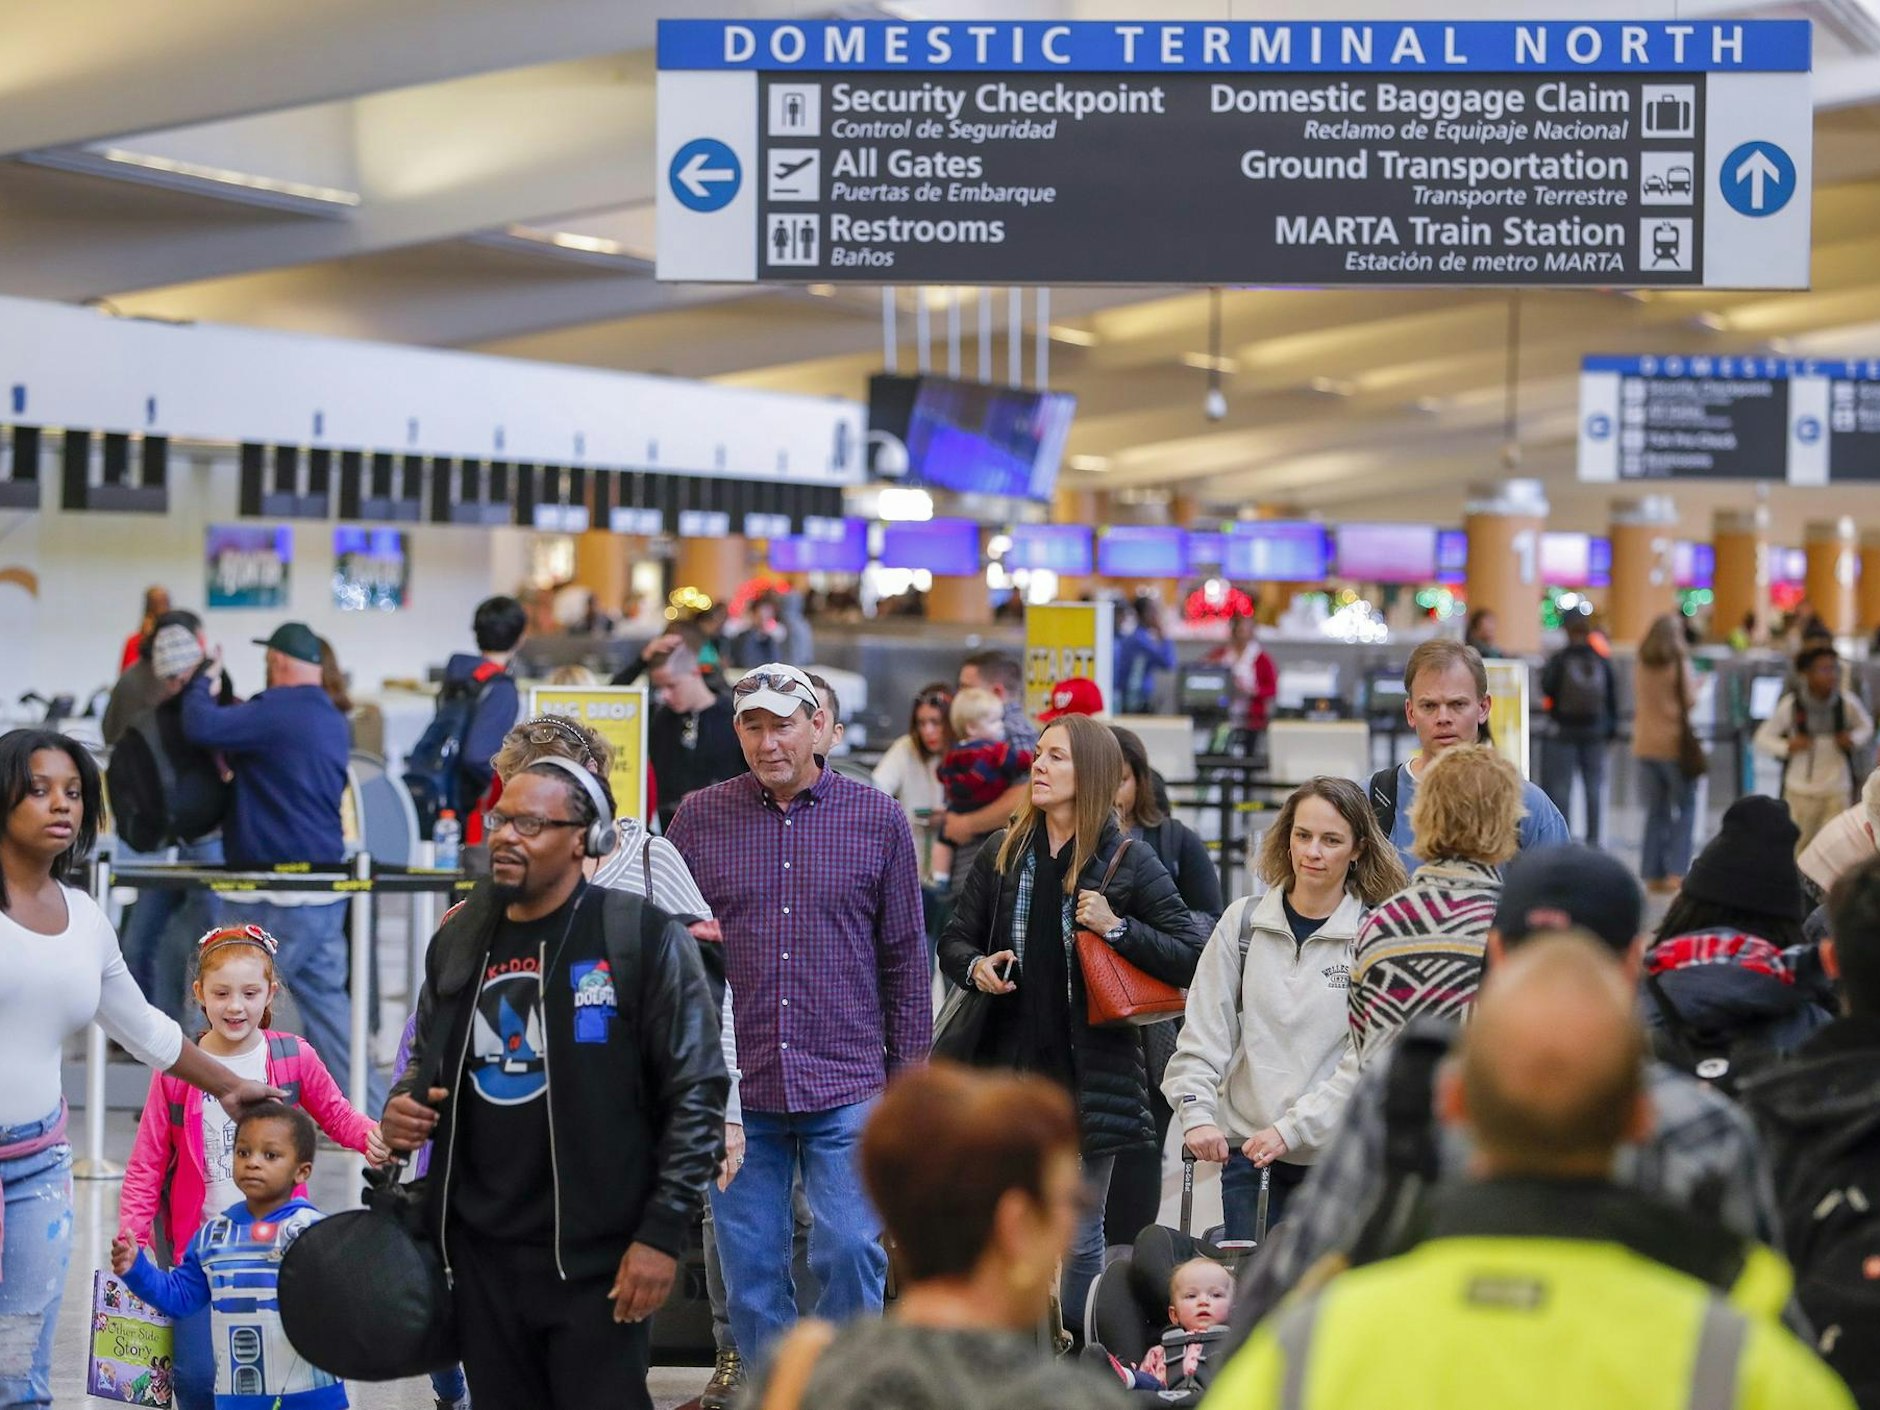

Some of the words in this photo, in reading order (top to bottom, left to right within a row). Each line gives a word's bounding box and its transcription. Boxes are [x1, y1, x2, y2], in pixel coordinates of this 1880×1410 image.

[724, 26, 1071, 64] DOMESTIC
[1115, 27, 1468, 64] TERMINAL
[1515, 26, 1743, 64] NORTH
[832, 83, 966, 117] Security
[975, 83, 1165, 119] Checkpoint
[1210, 82, 1367, 113] Domestic
[1377, 84, 1525, 119] Baggage
[1536, 82, 1630, 113] Claim
[832, 119, 911, 139] Control
[916, 119, 943, 139] de
[948, 119, 1057, 143] Seguridad
[1304, 120, 1396, 140] Reclamo
[1401, 120, 1429, 140] de
[1434, 120, 1529, 145] Equipaje
[1534, 120, 1629, 140] Nacional
[832, 149, 878, 178] All
[887, 149, 983, 178] Gates
[1241, 150, 1368, 180] Ground
[1377, 151, 1628, 185] Transportation
[832, 183, 910, 202] Puertas
[915, 183, 943, 202] de
[948, 183, 1057, 206] Embarque
[1413, 186, 1527, 209] Transporte
[1535, 186, 1628, 206] Terrestre
[831, 214, 1005, 243] Restrooms
[1275, 217, 1400, 245] MARTA
[1409, 217, 1492, 246] Train
[1503, 217, 1625, 246] Station
[831, 247, 894, 267] Baños
[1345, 250, 1433, 271] Estación
[1440, 251, 1467, 271] de
[1472, 253, 1538, 272] metro
[1544, 253, 1625, 272] MARTA
[1321, 964, 1350, 979] WELLES
[107, 1322, 136, 1337] Other
[138, 1327, 159, 1342] Side
[113, 1335, 152, 1360] Story
